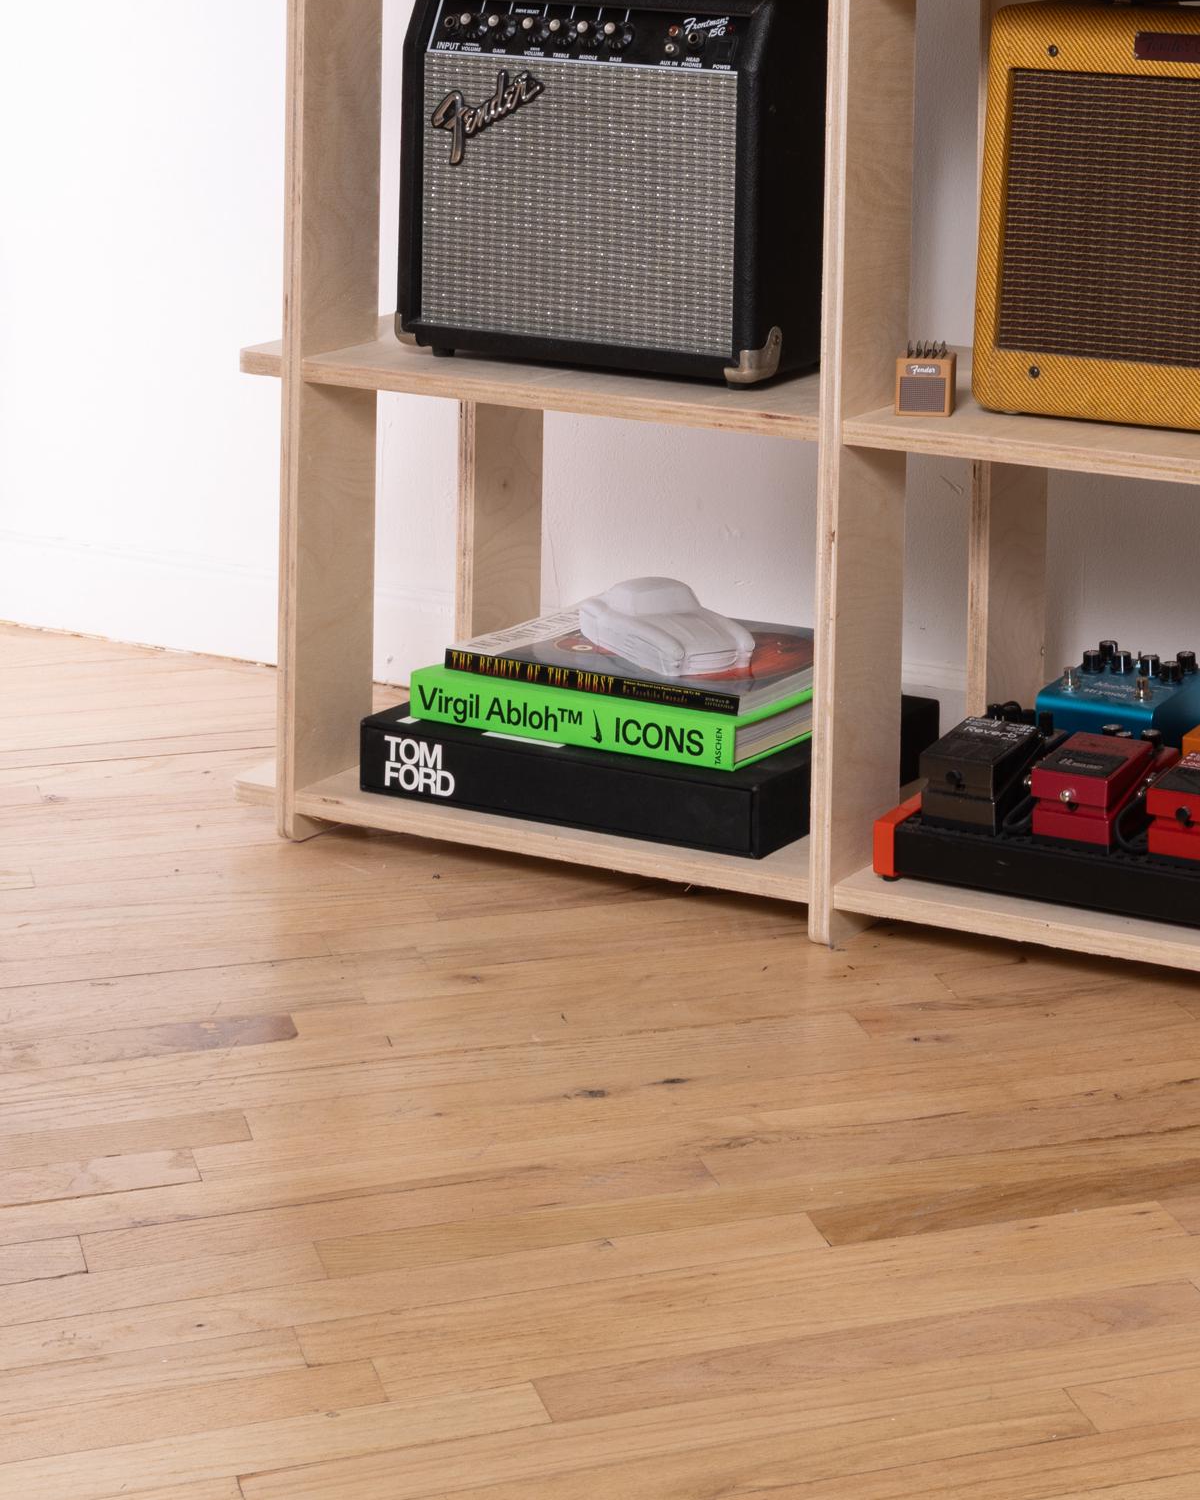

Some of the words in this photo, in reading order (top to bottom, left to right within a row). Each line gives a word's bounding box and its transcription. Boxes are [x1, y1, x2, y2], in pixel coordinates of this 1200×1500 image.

[436, 42, 460, 50] INPUT
[708, 26, 726, 37] 15G
[431, 69, 545, 166] Fender
[910, 364, 936, 375] Fender
[452, 651, 473, 671] THE
[480, 655, 522, 677] BEAUTY
[527, 663, 540, 681] OF
[548, 666, 569, 687] THE
[418, 685, 480, 723] Virgil
[615, 717, 704, 756] ICONS
[964, 726, 1017, 738] Reverb
[384, 735, 443, 770] TOM
[384, 760, 455, 797] FORD
